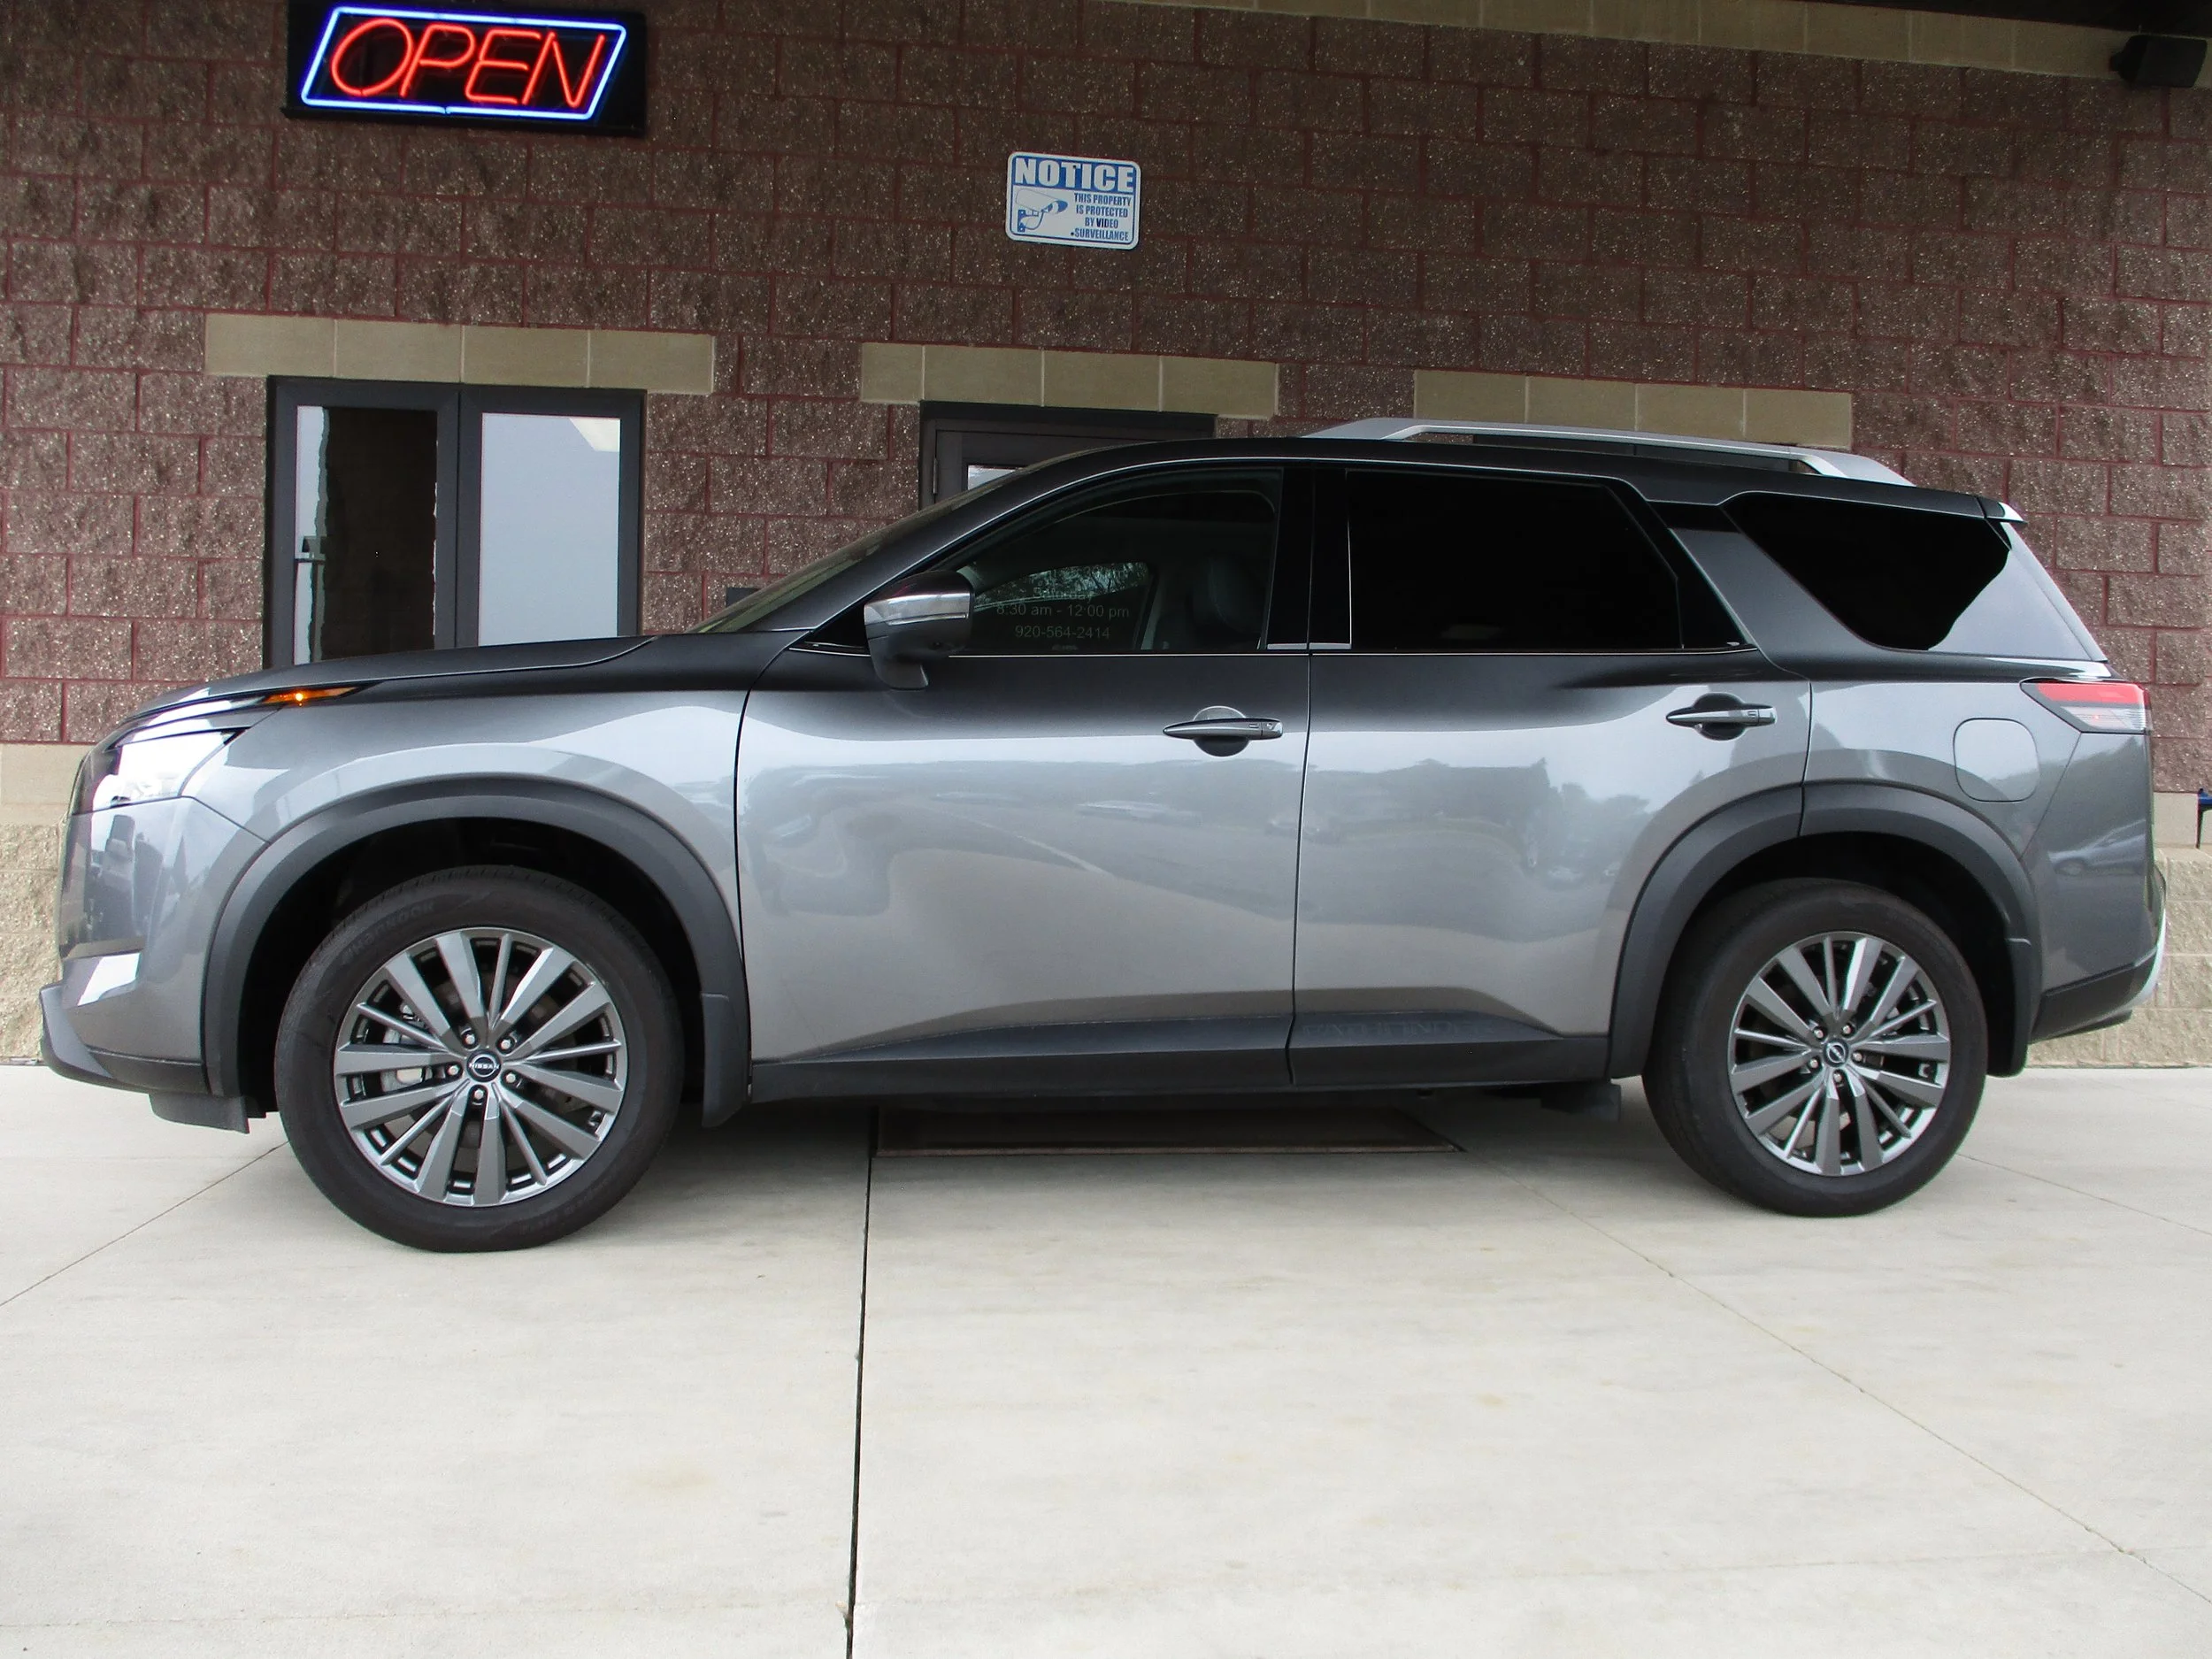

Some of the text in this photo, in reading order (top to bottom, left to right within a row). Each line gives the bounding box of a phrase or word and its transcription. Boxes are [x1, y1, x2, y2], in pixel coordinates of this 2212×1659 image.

[330, 18, 606, 108] OPEN
[1014, 157, 1134, 193] NOTICE
[1074, 192, 1132, 206] THIS PROPERTY
[1076, 204, 1128, 218] IS PROTECTED
[1085, 217, 1119, 229] BY VIDEO
[1074, 227, 1129, 242] SURVEILLANCE
[996, 604, 1026, 616] 8:30
[1031, 607, 1052, 617] am
[1067, 604, 1104, 618] 12:00
[1109, 607, 1130, 619] pm
[1014, 626, 1110, 640] 920-564-2414
[468, 1062, 500, 1071] NISSAN
